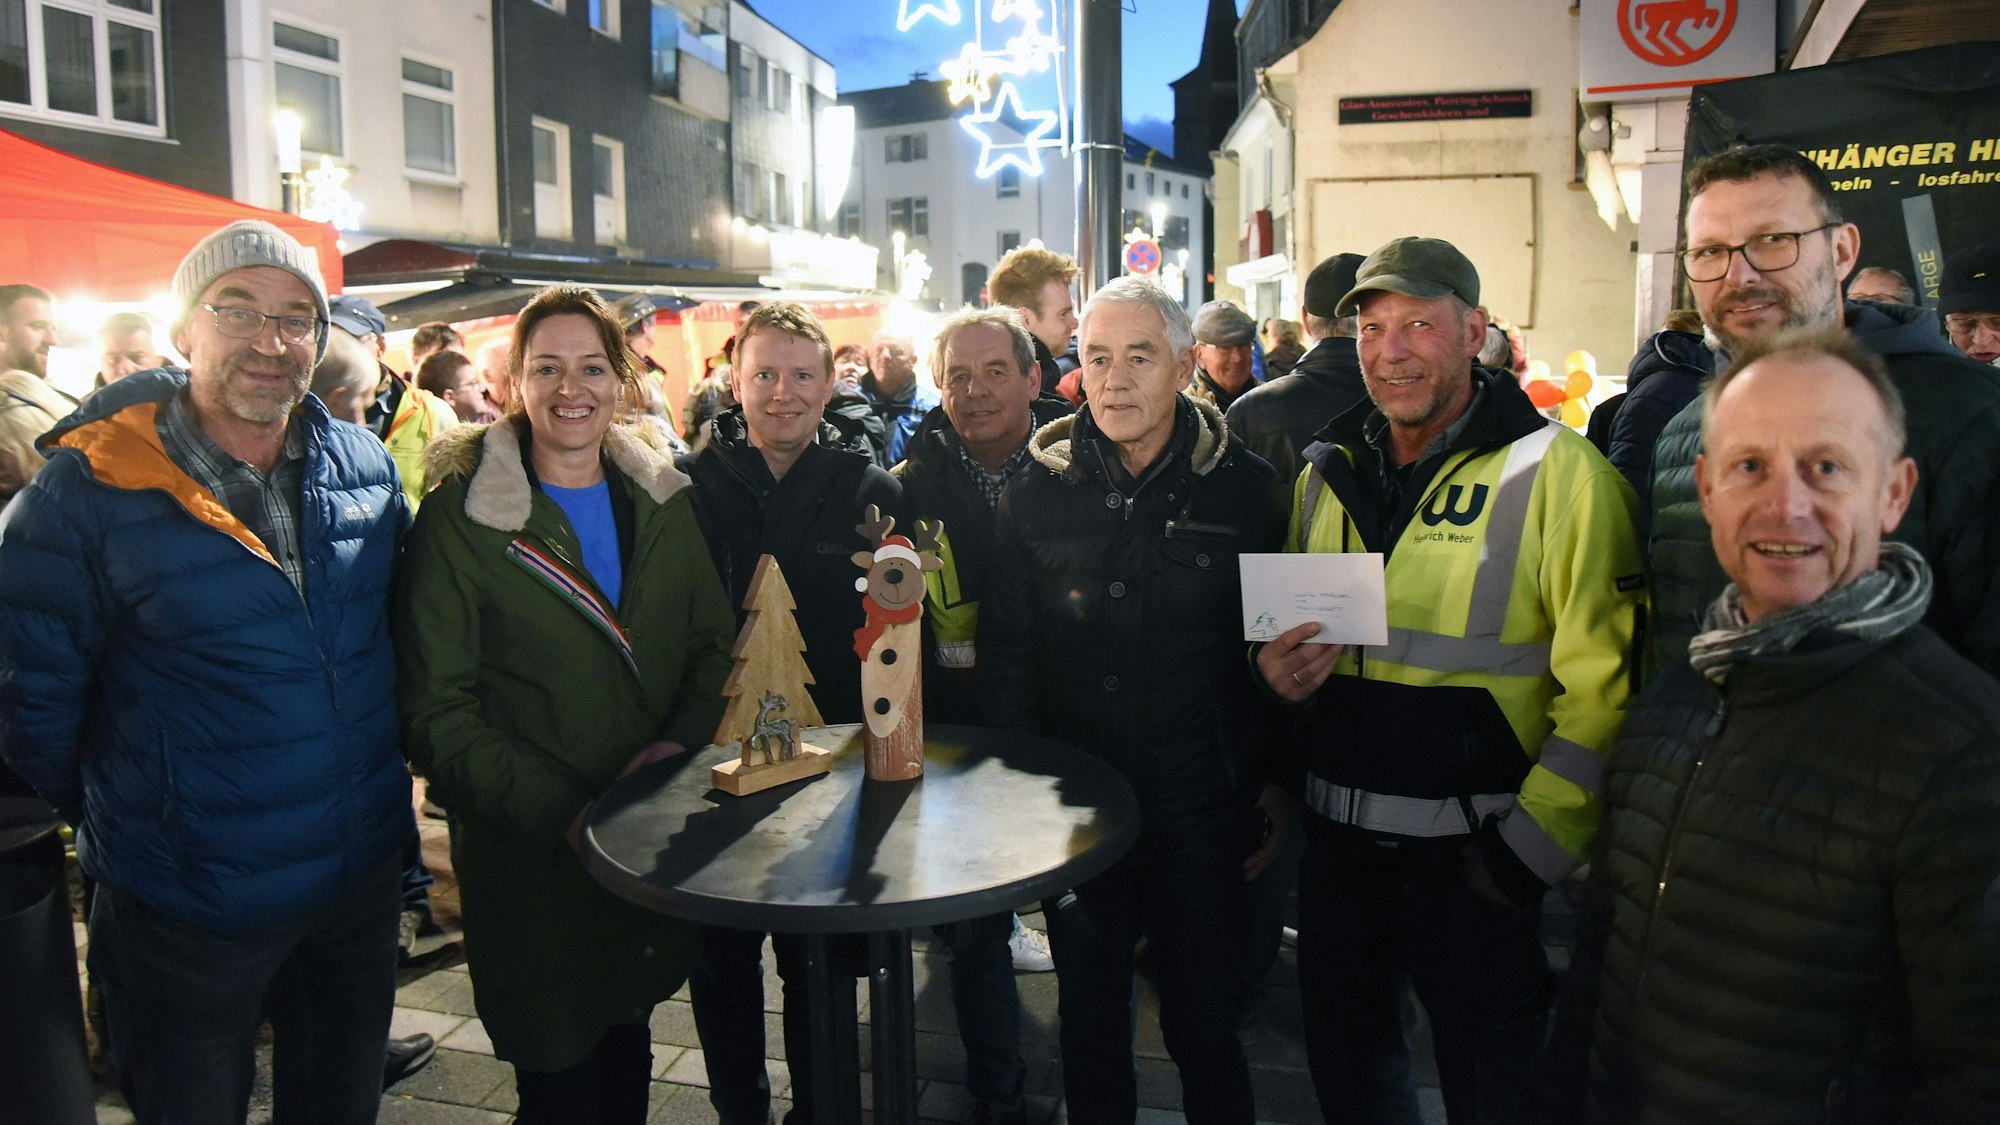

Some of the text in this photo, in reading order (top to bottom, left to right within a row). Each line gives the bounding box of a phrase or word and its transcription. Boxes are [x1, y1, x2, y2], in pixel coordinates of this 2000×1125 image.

[1371, 107, 1489, 120] Geschenkideen und
[1448, 532, 1474, 544] Weber
